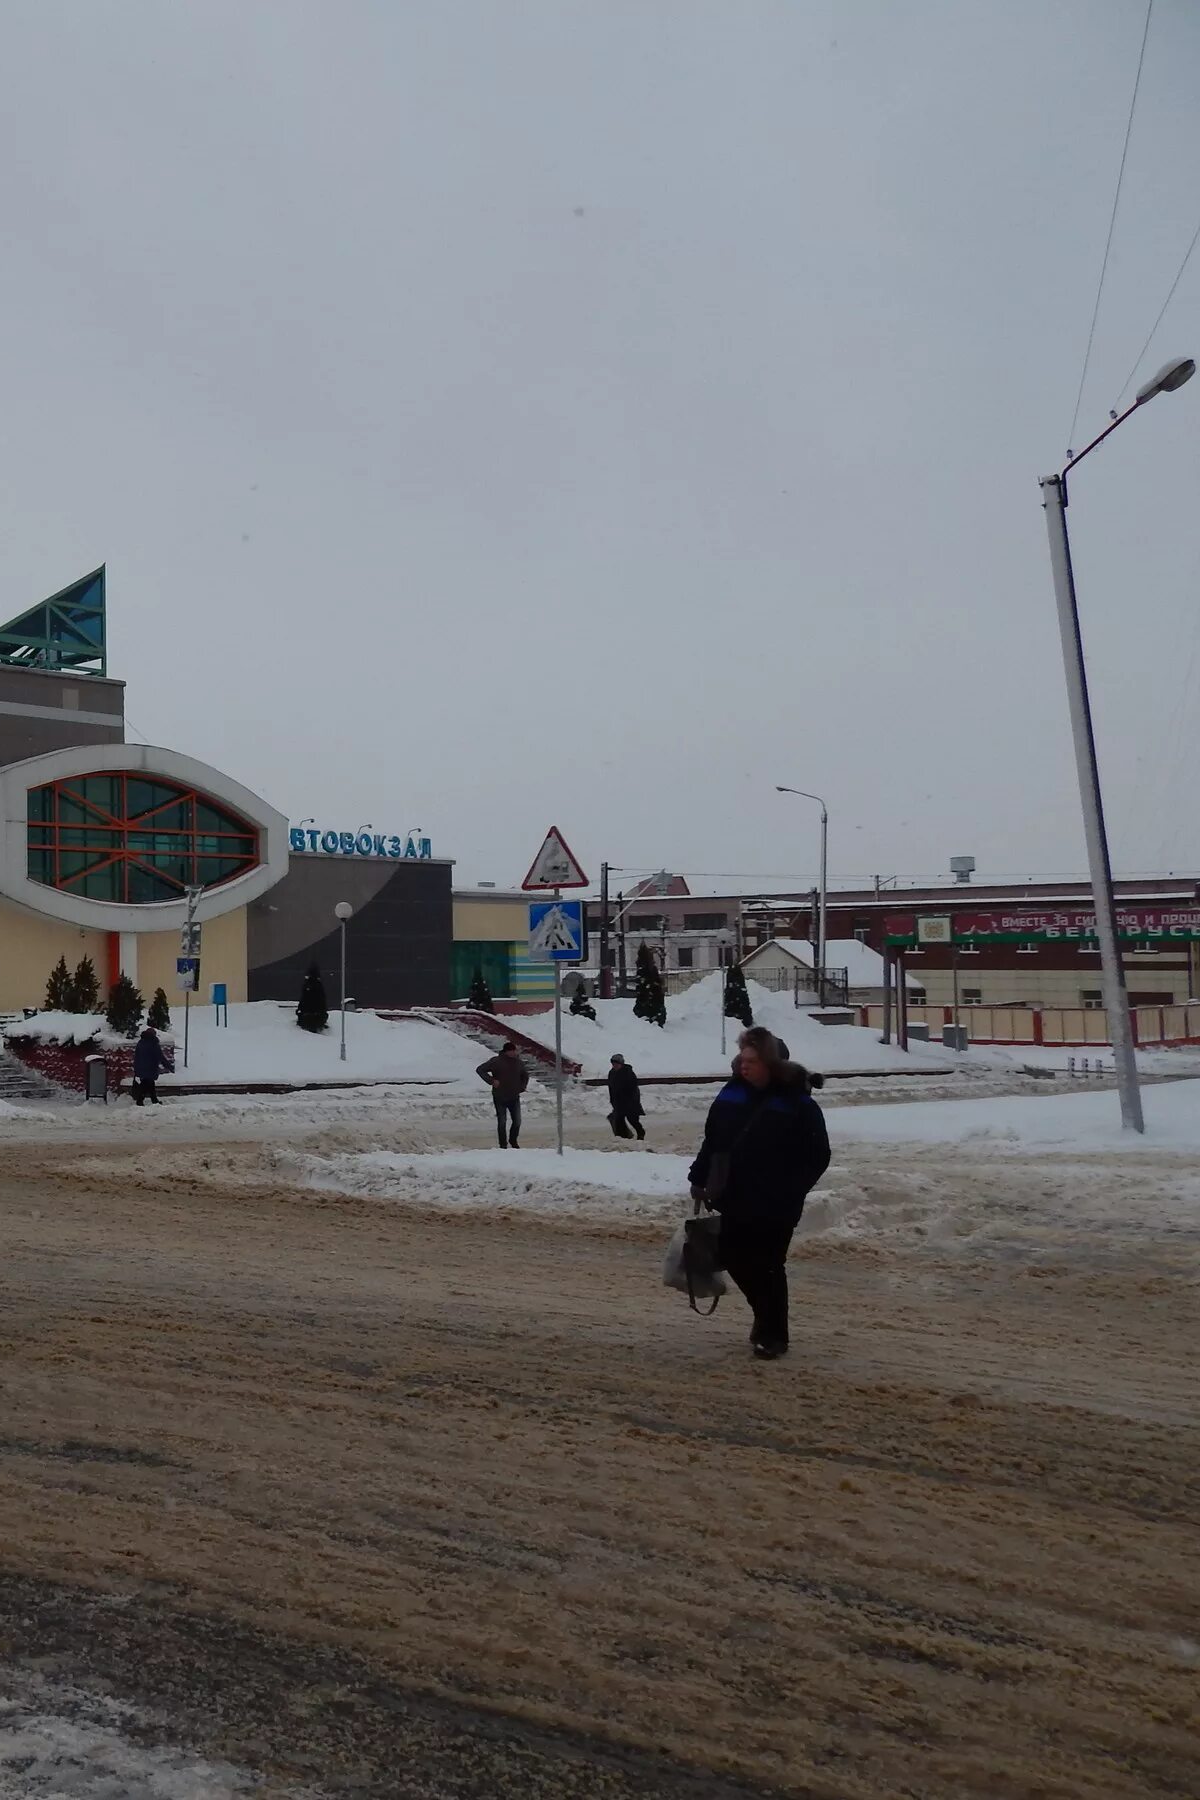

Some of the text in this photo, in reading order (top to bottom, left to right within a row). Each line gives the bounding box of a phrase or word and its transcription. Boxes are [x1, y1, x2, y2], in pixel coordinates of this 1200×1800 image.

[290, 827, 432, 859] ВТОВОКЗАЛ
[1001, 916, 1047, 928] ВМЕСТЕ
[1075, 915, 1138, 927] СИЛУЮ
[1045, 925, 1200, 939] БЕЛРУСЬ
